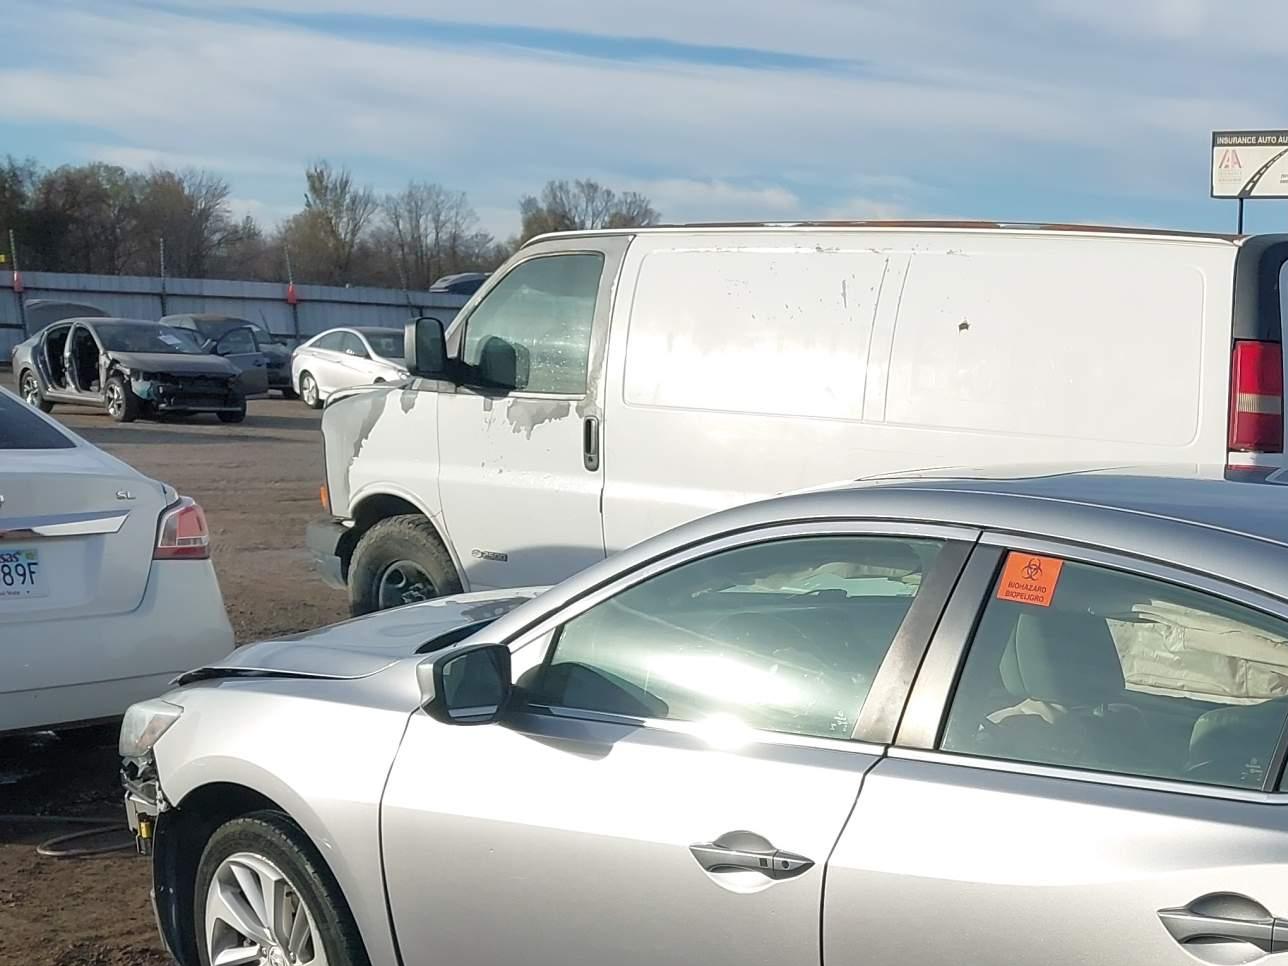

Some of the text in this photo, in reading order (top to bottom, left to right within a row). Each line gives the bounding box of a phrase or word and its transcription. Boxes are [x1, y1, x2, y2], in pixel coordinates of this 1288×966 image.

[1216, 136, 1257, 145] INSURANCE
[1257, 136, 1277, 144] AUTO
[115, 489, 136, 501] SL
[1007, 581, 1047, 593] BIOHAZARD
[1004, 590, 1045, 602] BIOPELIGRO
